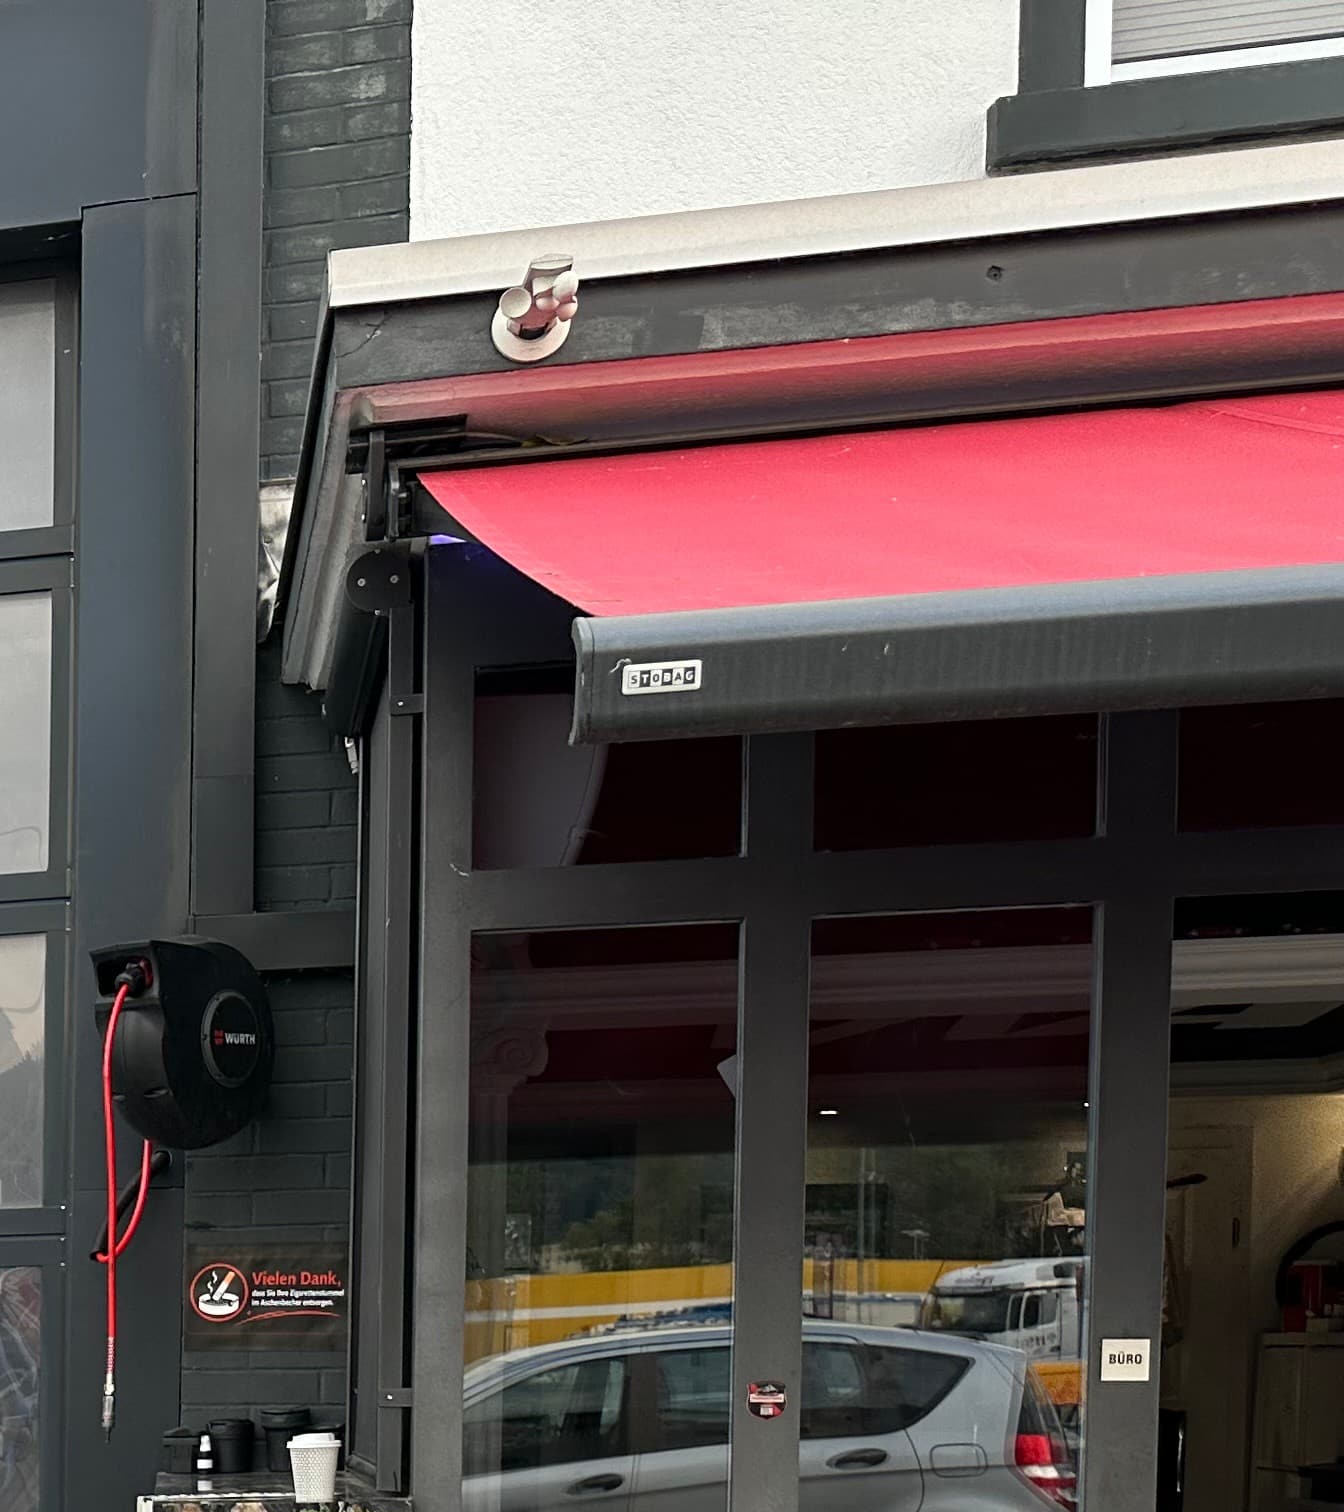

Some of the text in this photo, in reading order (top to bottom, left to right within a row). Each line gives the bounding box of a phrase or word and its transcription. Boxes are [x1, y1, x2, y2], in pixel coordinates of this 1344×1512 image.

[630, 669, 694, 685] STOBAG
[252, 1270, 342, 1288] Vielen Dank,
[1109, 1350, 1142, 1365] BÜRO
